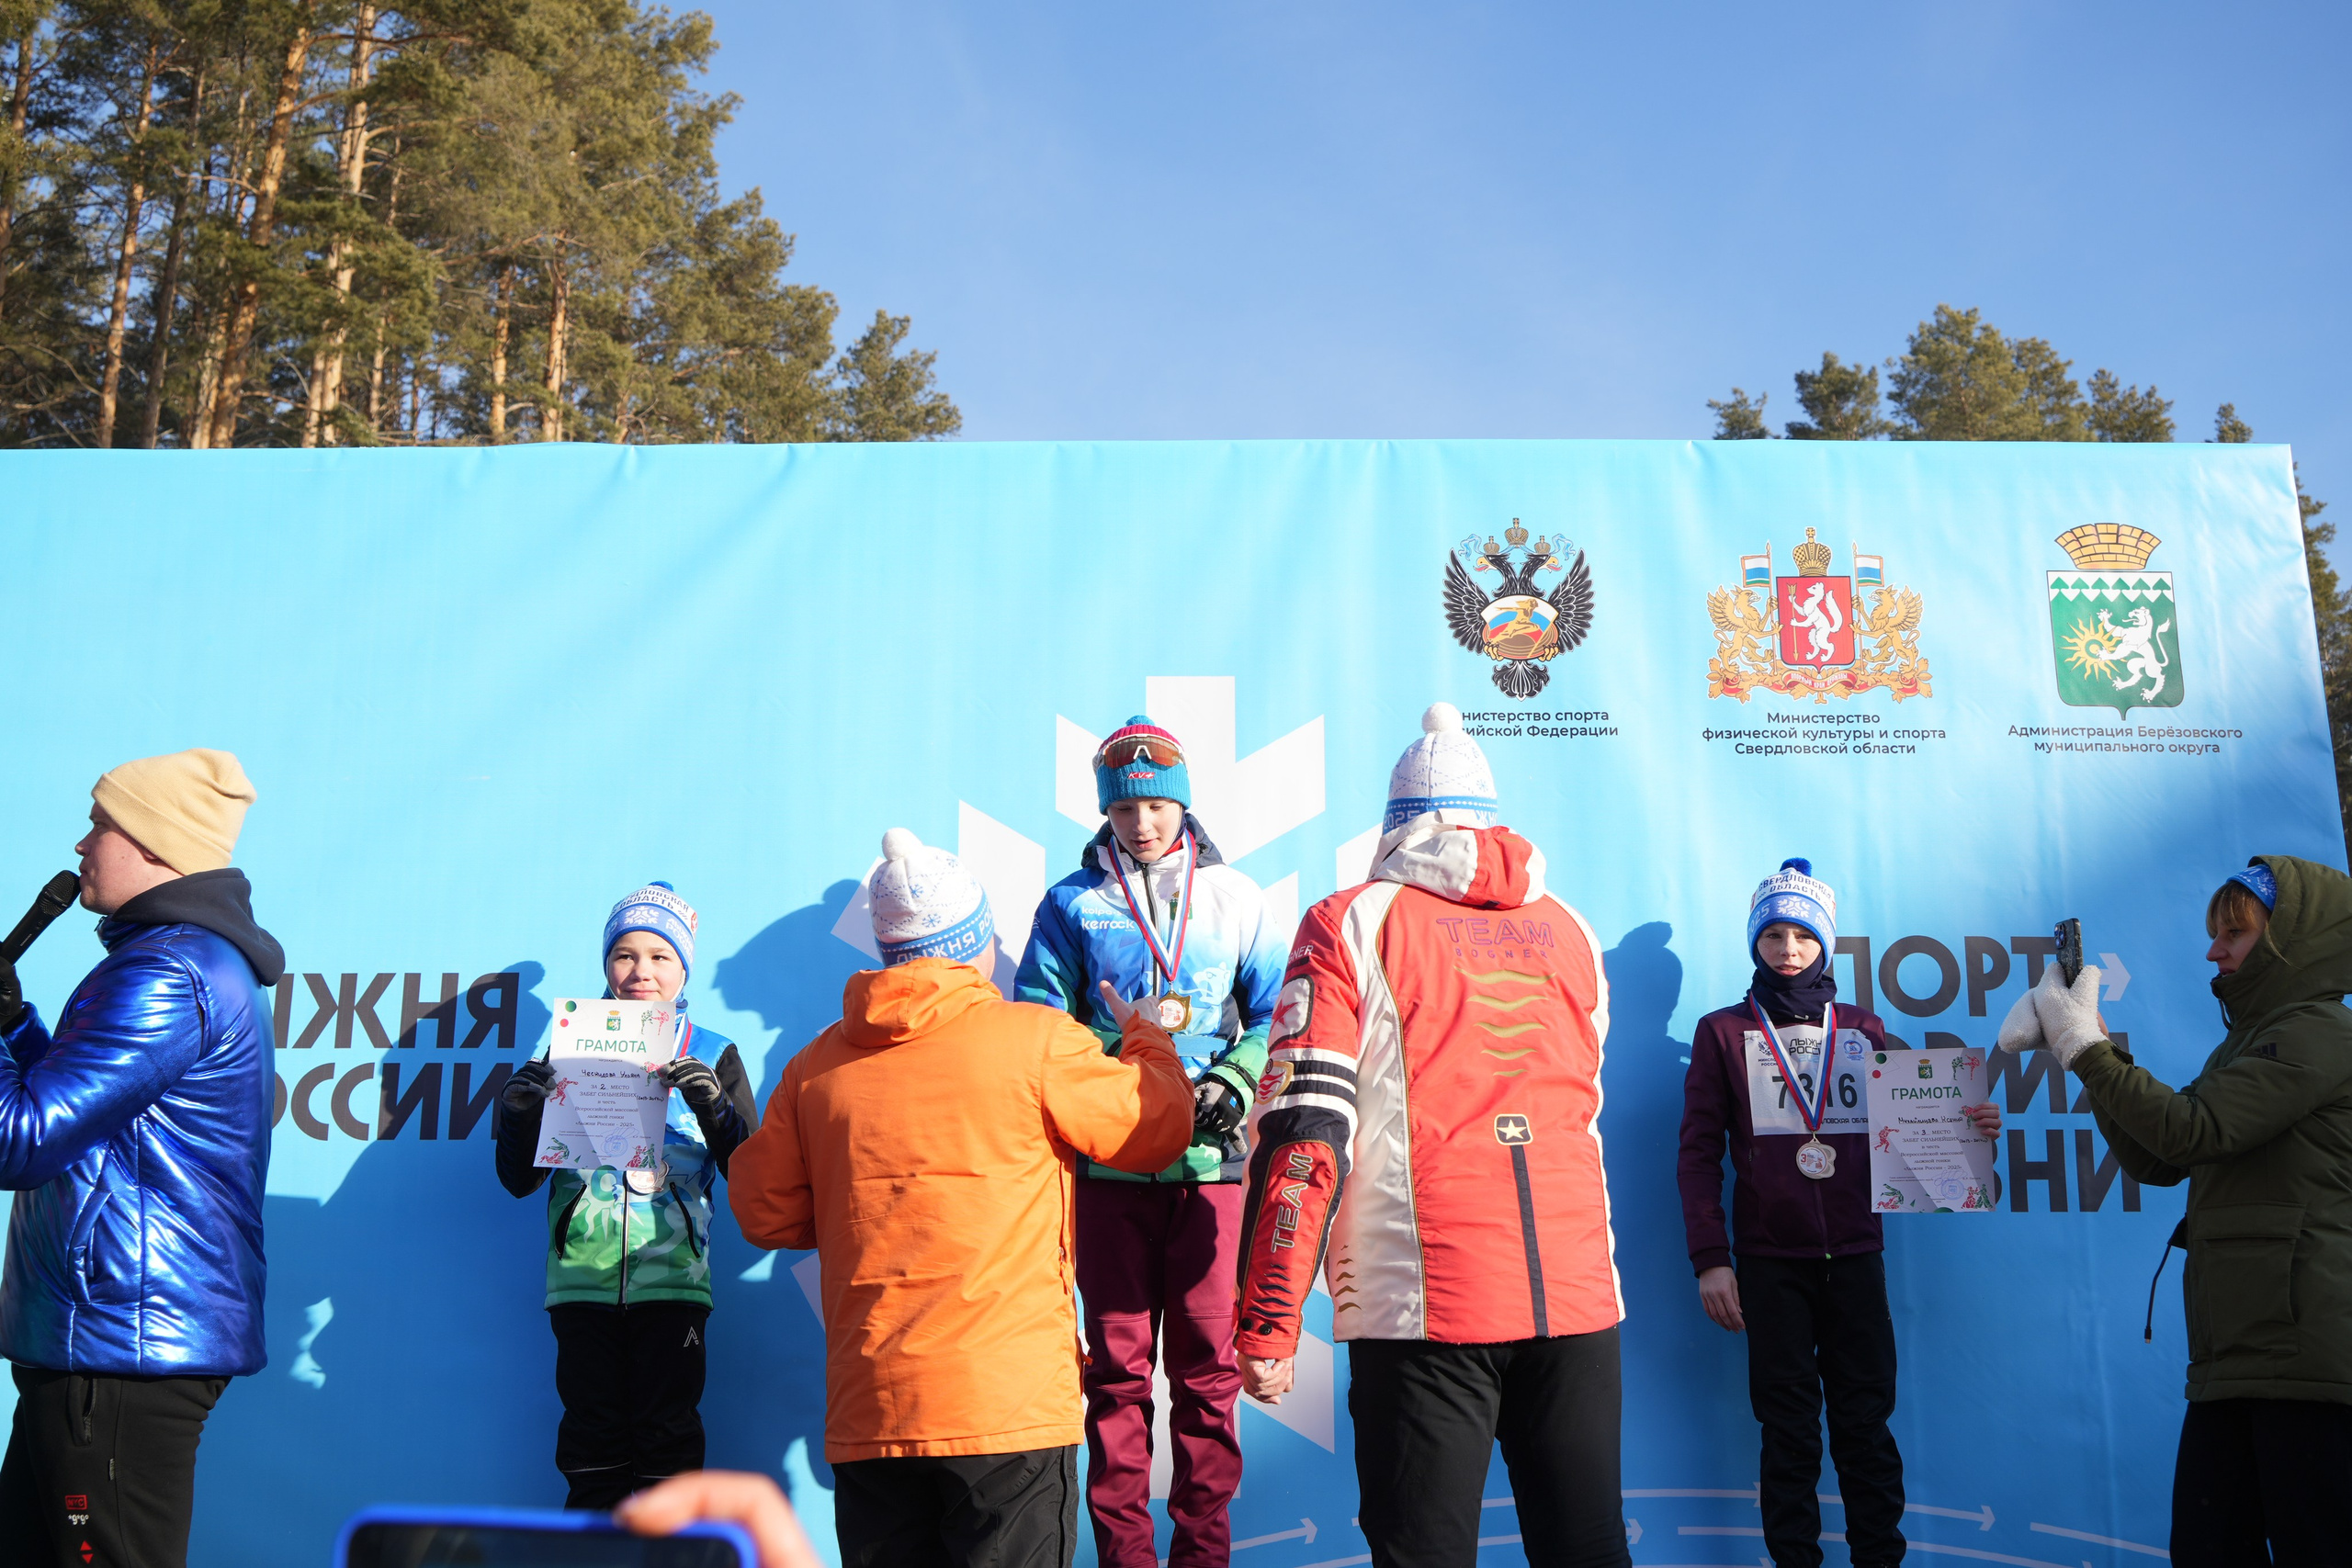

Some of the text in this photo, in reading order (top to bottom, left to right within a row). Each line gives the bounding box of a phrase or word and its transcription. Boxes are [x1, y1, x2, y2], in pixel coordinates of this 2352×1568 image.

[1462, 711, 1609, 723] нистерство спорта
[1767, 712, 1881, 726] Министерство
[1461, 725, 1618, 739] ийской Федерации
[1702, 728, 1946, 741] физической культуры и спорта
[2007, 724, 2244, 740] Администрация Берёзовского
[1735, 741, 1916, 756] Свердловской области
[2034, 740, 2221, 756] муниципального округа
[1770, 883, 1821, 901] ОБЛАСТЬ
[619, 895, 674, 909] ОБЛАСТЬ
[625, 889, 689, 913] ДЛОВСКАЯ
[1081, 918, 1136, 930] kerrock
[1436, 918, 1555, 948] TEAM
[1288, 944, 1315, 964] GNER
[1455, 948, 1548, 959] BOGNER
[1832, 935, 2058, 1017] ПОРТ
[273, 973, 520, 1049] ЖНЯ
[576, 1039, 647, 1054] ГРАМОТА
[1790, 1038, 1822, 1047] ЛЫЖН
[1788, 1045, 1822, 1056] РОСС
[1891, 1087, 1962, 1100] ГРАМОТА
[272, 1063, 514, 1142] ССИИ
[1270, 1152, 1315, 1254] TEAM
